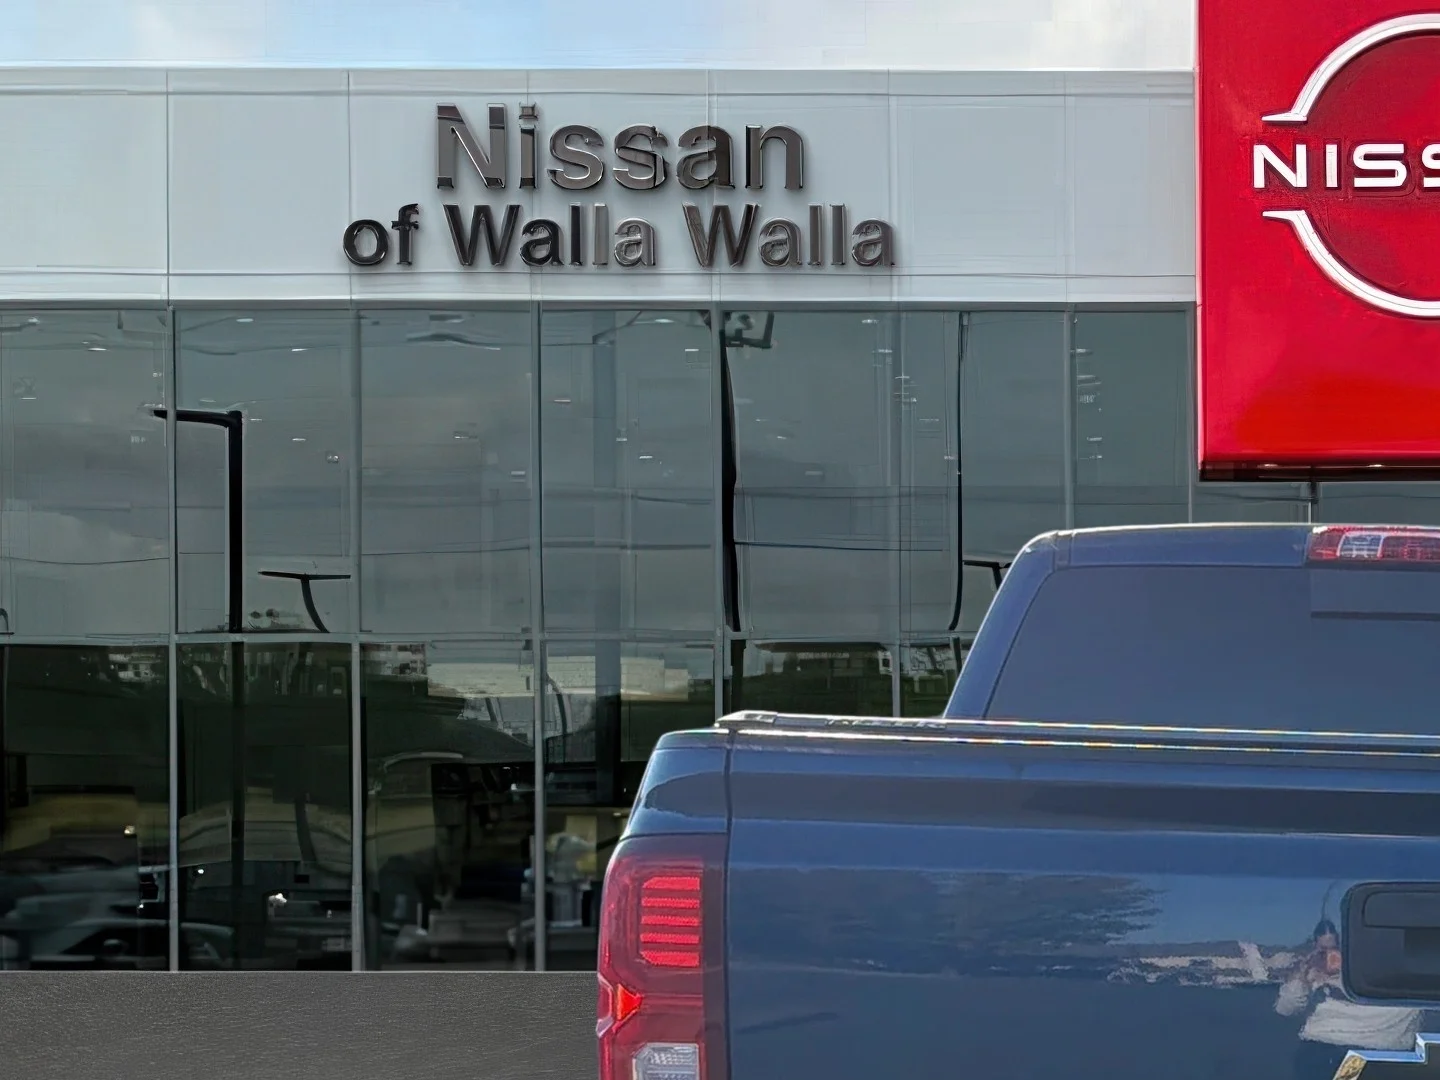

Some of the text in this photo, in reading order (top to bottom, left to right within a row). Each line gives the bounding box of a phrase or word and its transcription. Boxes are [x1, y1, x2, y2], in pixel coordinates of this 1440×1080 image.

[436, 102, 805, 190] Nissan
[341, 203, 896, 268] of Walla Walla
